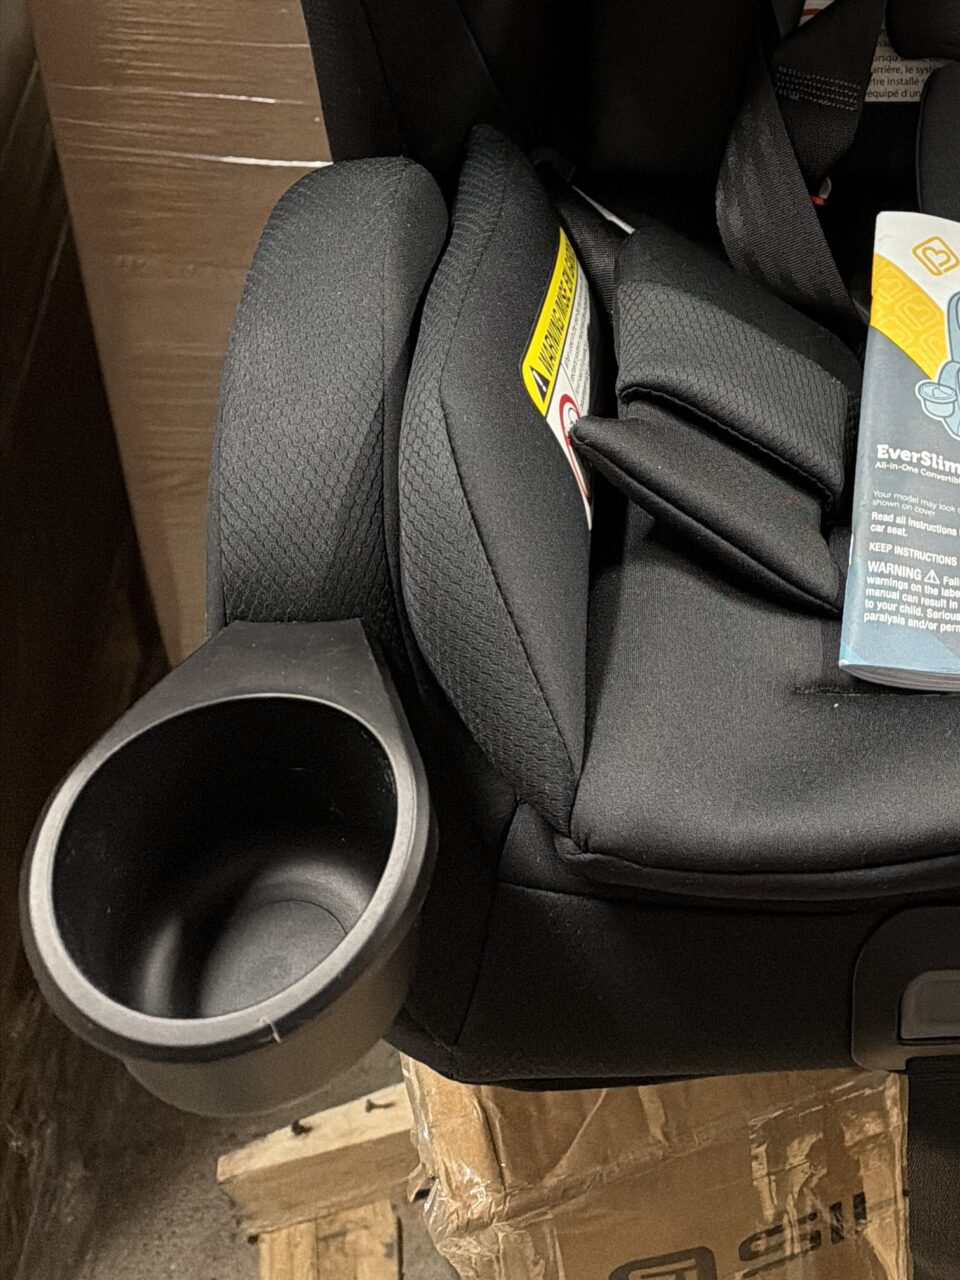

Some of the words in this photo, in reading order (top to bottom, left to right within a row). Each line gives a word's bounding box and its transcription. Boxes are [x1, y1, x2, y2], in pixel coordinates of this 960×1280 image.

[875, 461, 919, 474] All-in-One
[872, 490, 892, 498] Your
[893, 493, 919, 504] model
[920, 499, 937, 510] may
[938, 503, 956, 513] look
[872, 499, 900, 508] shown
[901, 503, 913, 511] on
[870, 524, 886, 532] car
[886, 526, 908, 537] seat.
[871, 511, 894, 522] Read
[895, 515, 907, 525] all
[908, 517, 957, 536] instructions
[868, 542, 893, 553] KEEP
[894, 545, 958, 566] INSTRUCTIONS
[867, 560, 922, 581] WARNING
[866, 576, 909, 590] warnings
[910, 582, 922, 592] on
[924, 584, 939, 595] the
[864, 599, 875, 608] to
[876, 602, 898, 611] your
[899, 604, 924, 617] child.
[865, 588, 900, 600] manual
[901, 593, 919, 604] can
[920, 596, 947, 609] result
[949, 599, 958, 609] in
[863, 612, 906, 626] paralysis
[907, 618, 939, 630] and/or
